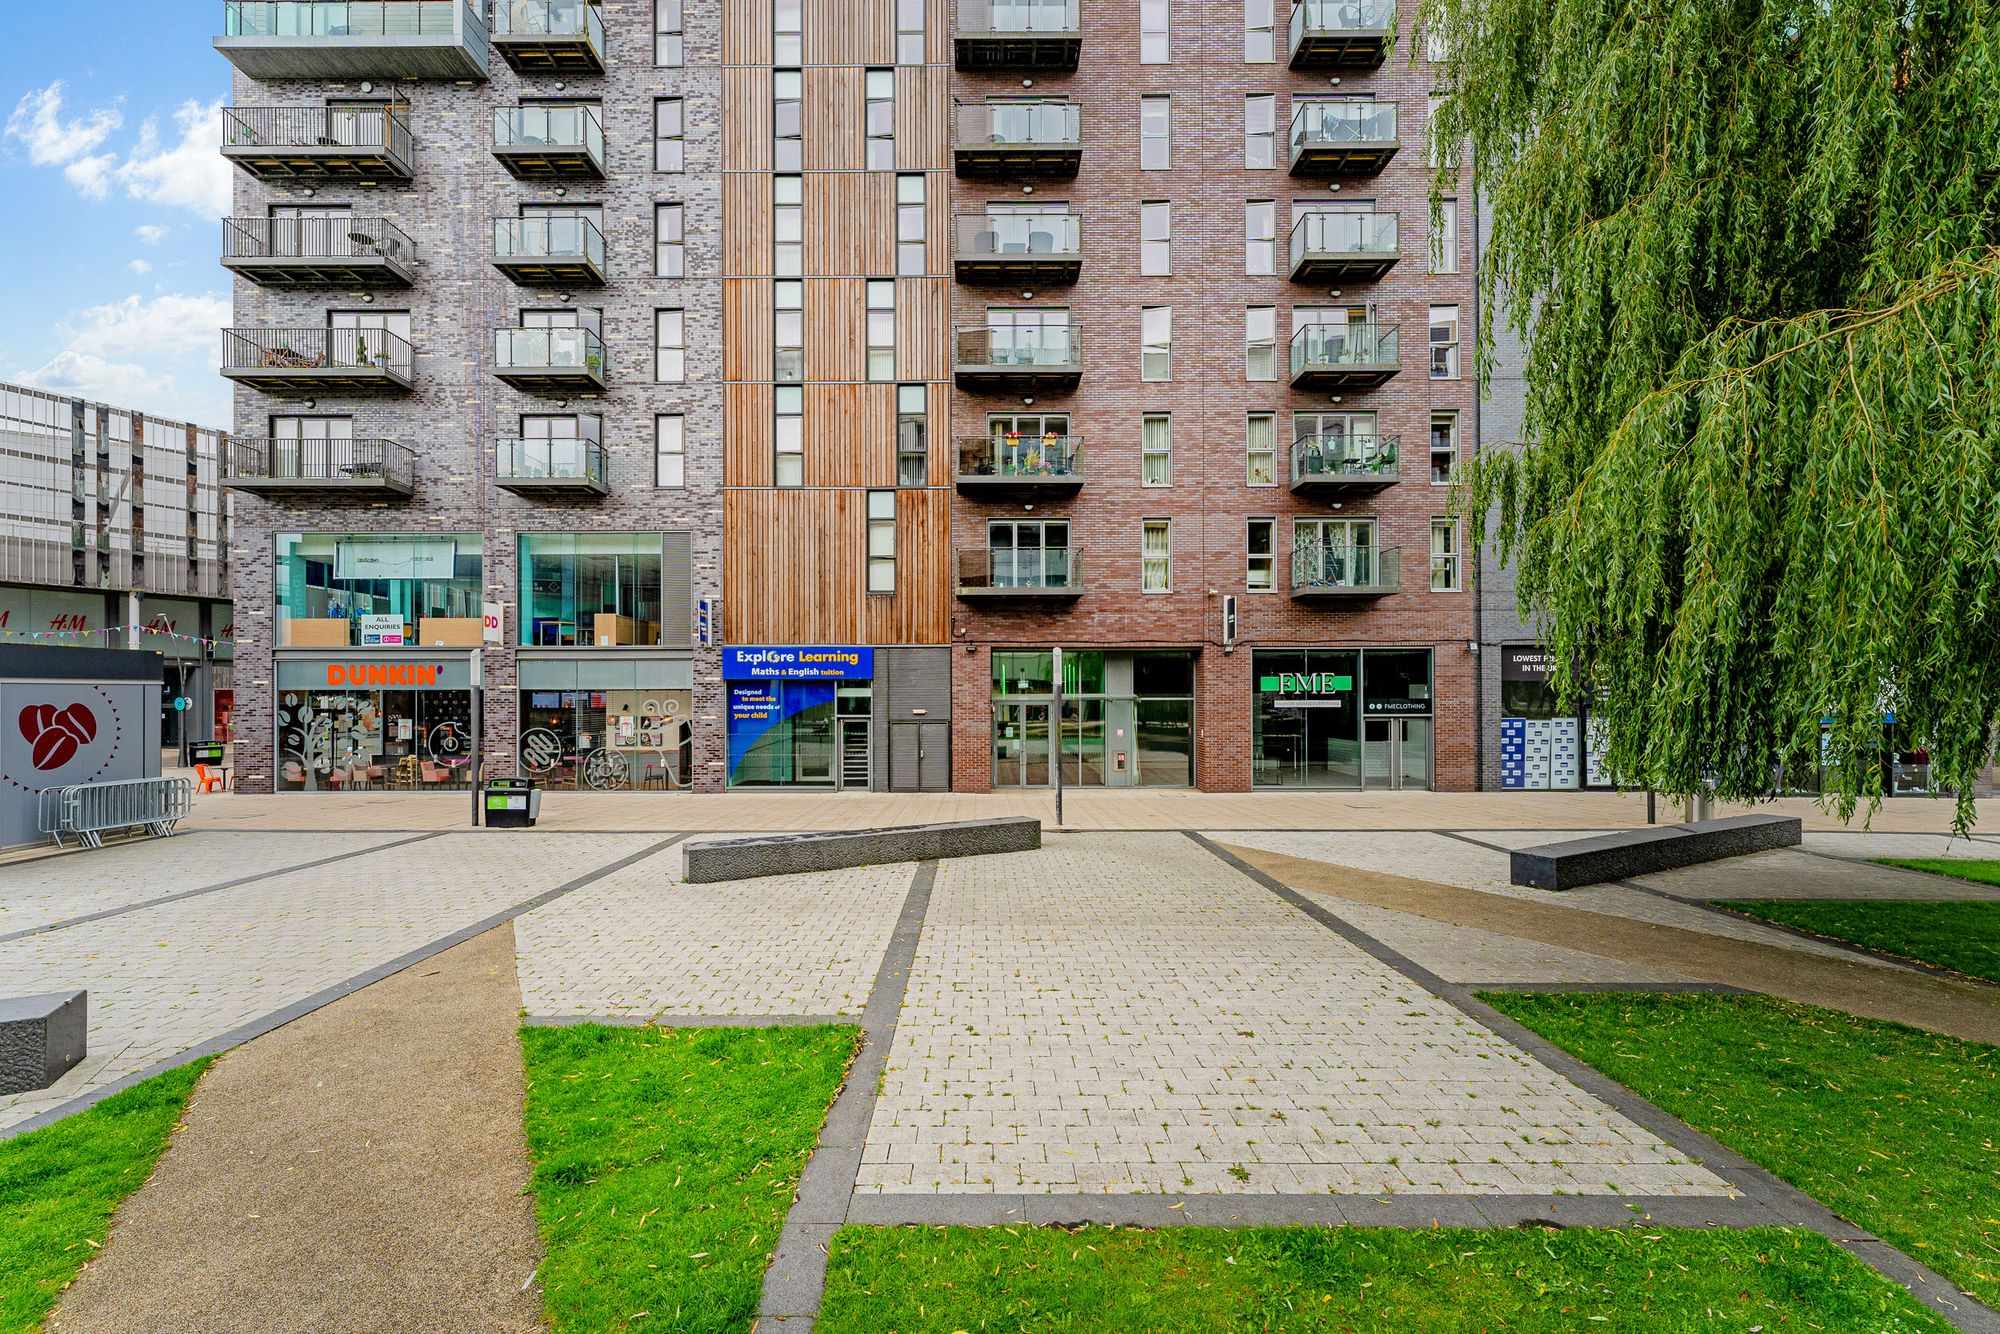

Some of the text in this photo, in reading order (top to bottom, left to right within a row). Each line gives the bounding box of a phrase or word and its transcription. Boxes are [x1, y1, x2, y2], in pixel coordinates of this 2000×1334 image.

[50, 613, 87, 631] H&M
[484, 615, 498, 628] DD
[737, 650, 858, 665] Explore Learning
[327, 664, 444, 686] DUNKIN'
[788, 668, 819, 677] English
[1278, 672, 1336, 694] FME
[734, 712, 750, 720] your
